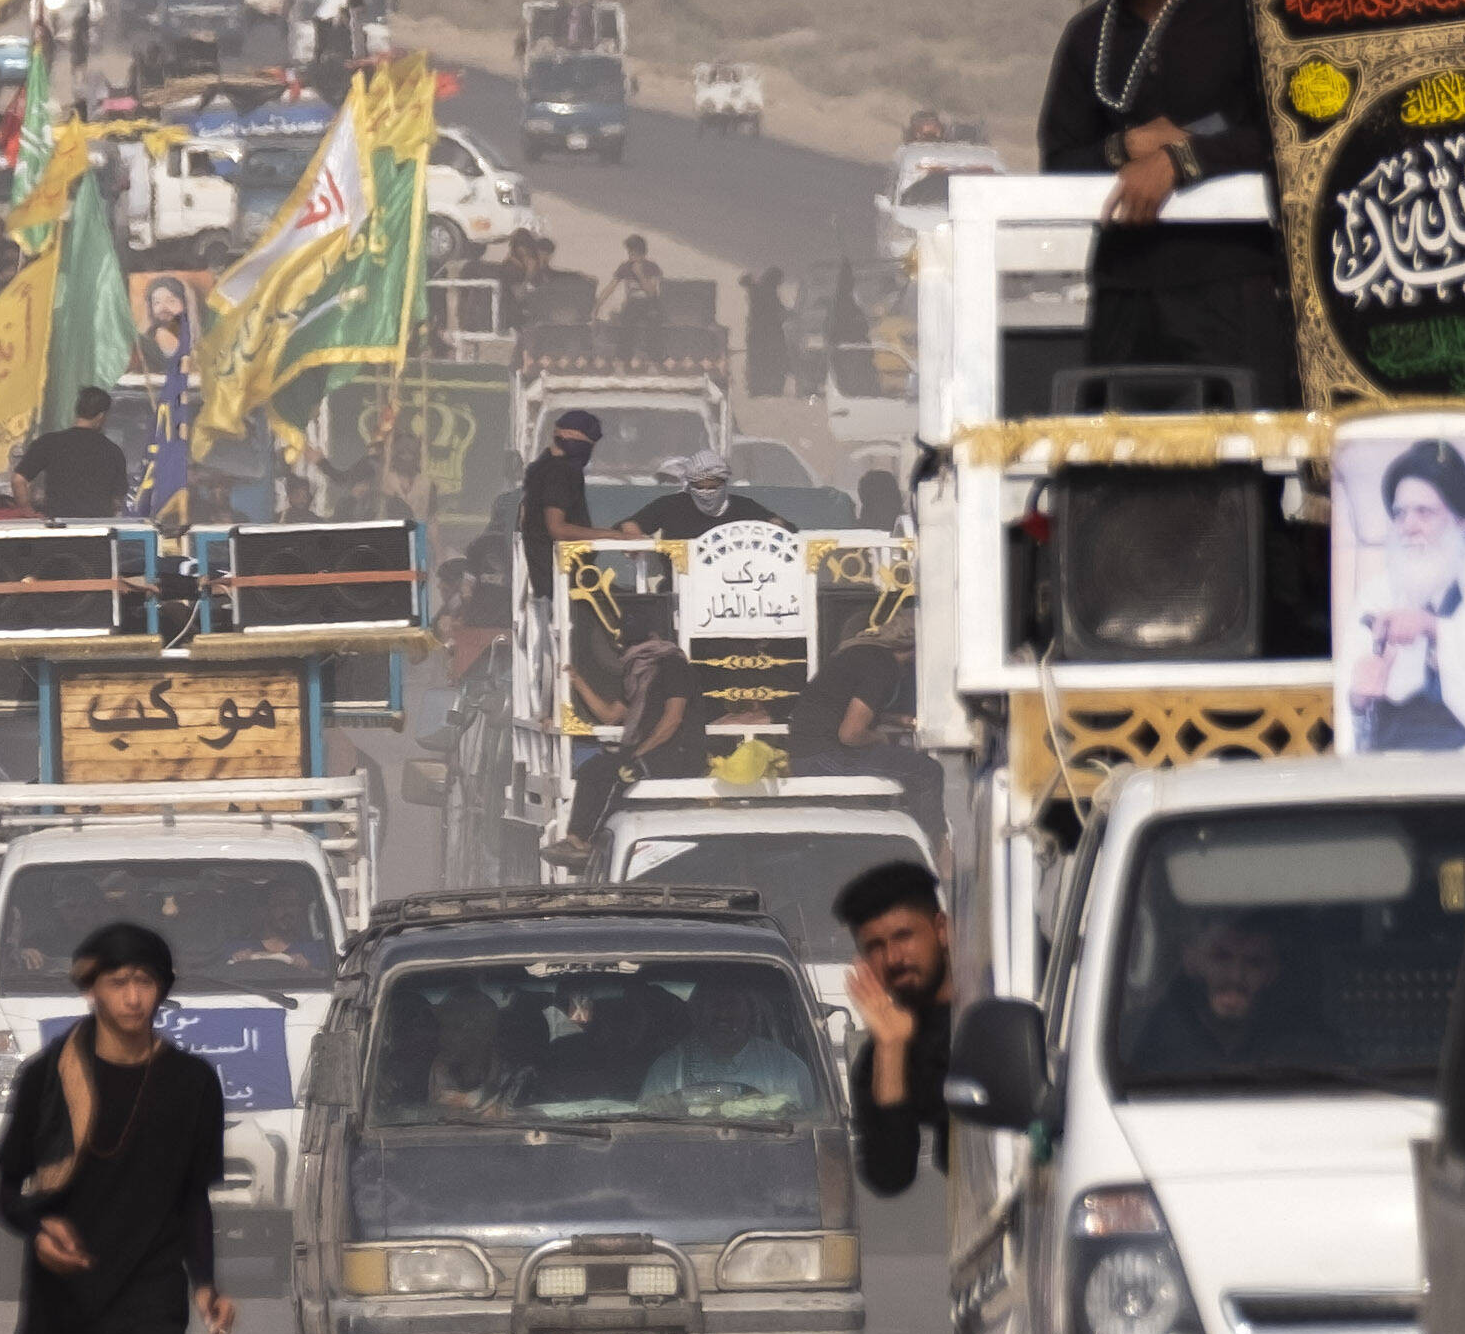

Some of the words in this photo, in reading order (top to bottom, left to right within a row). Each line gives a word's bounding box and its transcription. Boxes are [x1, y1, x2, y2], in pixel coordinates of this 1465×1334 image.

[720, 560, 776, 592] موكب
[87, 677, 276, 750] موكب
[152, 1005, 201, 1033] موك
